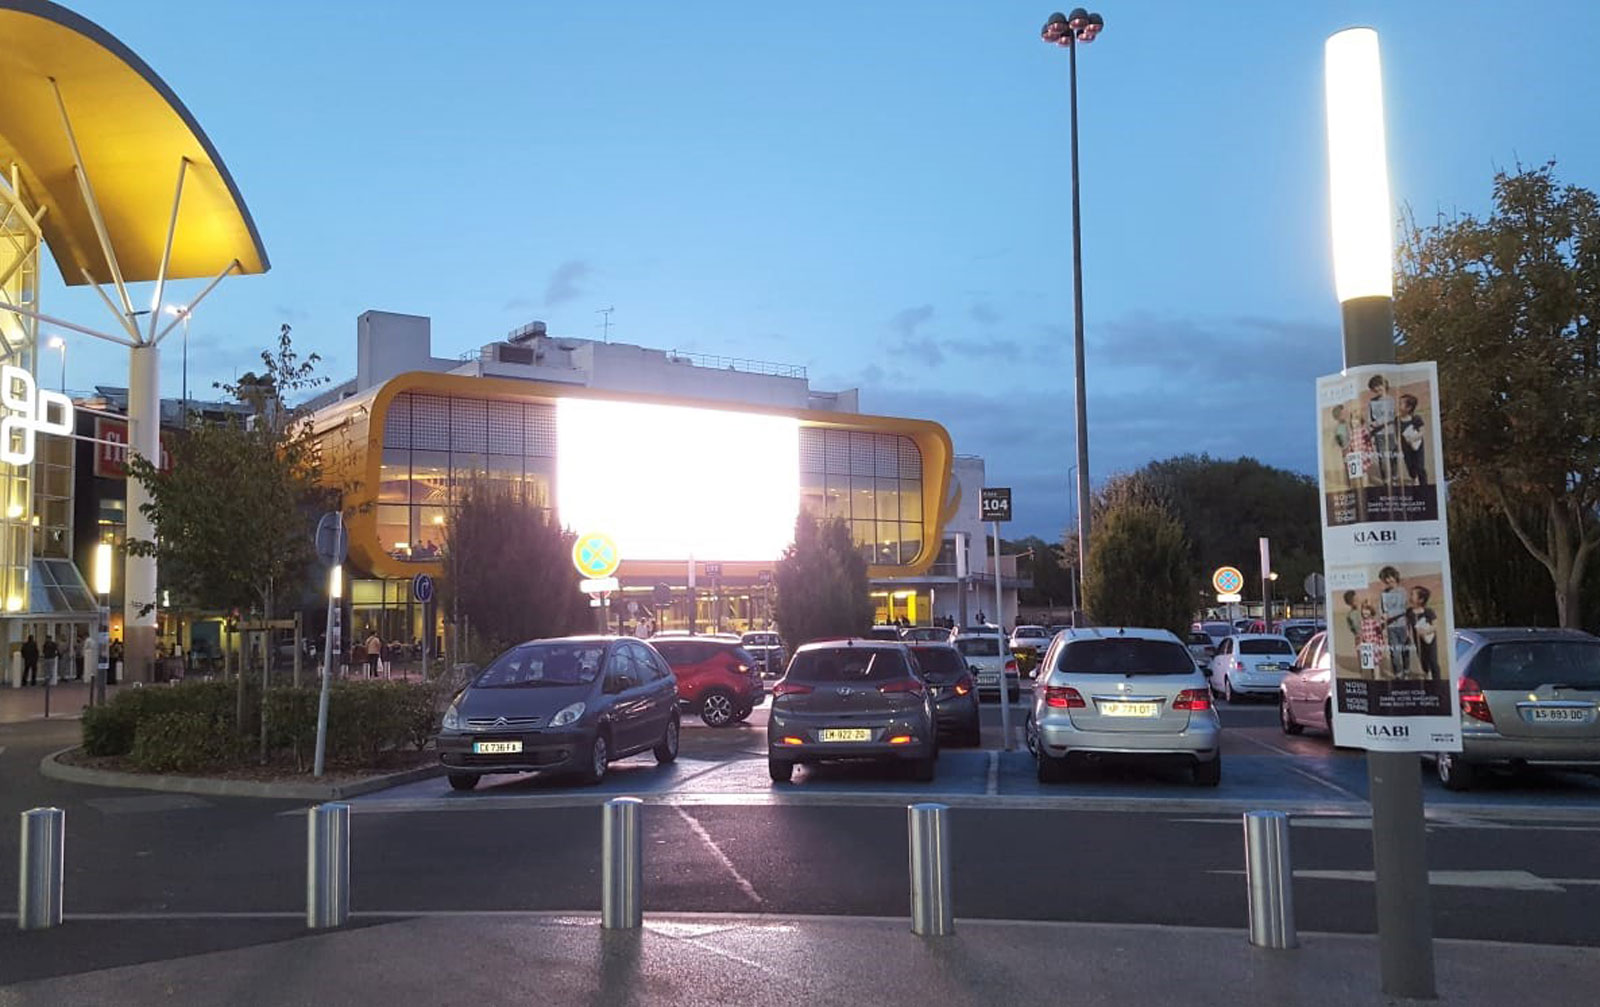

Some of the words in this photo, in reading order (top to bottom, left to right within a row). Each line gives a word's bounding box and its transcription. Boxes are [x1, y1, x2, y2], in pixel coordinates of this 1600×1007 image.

[983, 499, 1008, 511] 104
[1354, 530, 1397, 542] KIABI
[1366, 725, 1410, 737] KIABI
